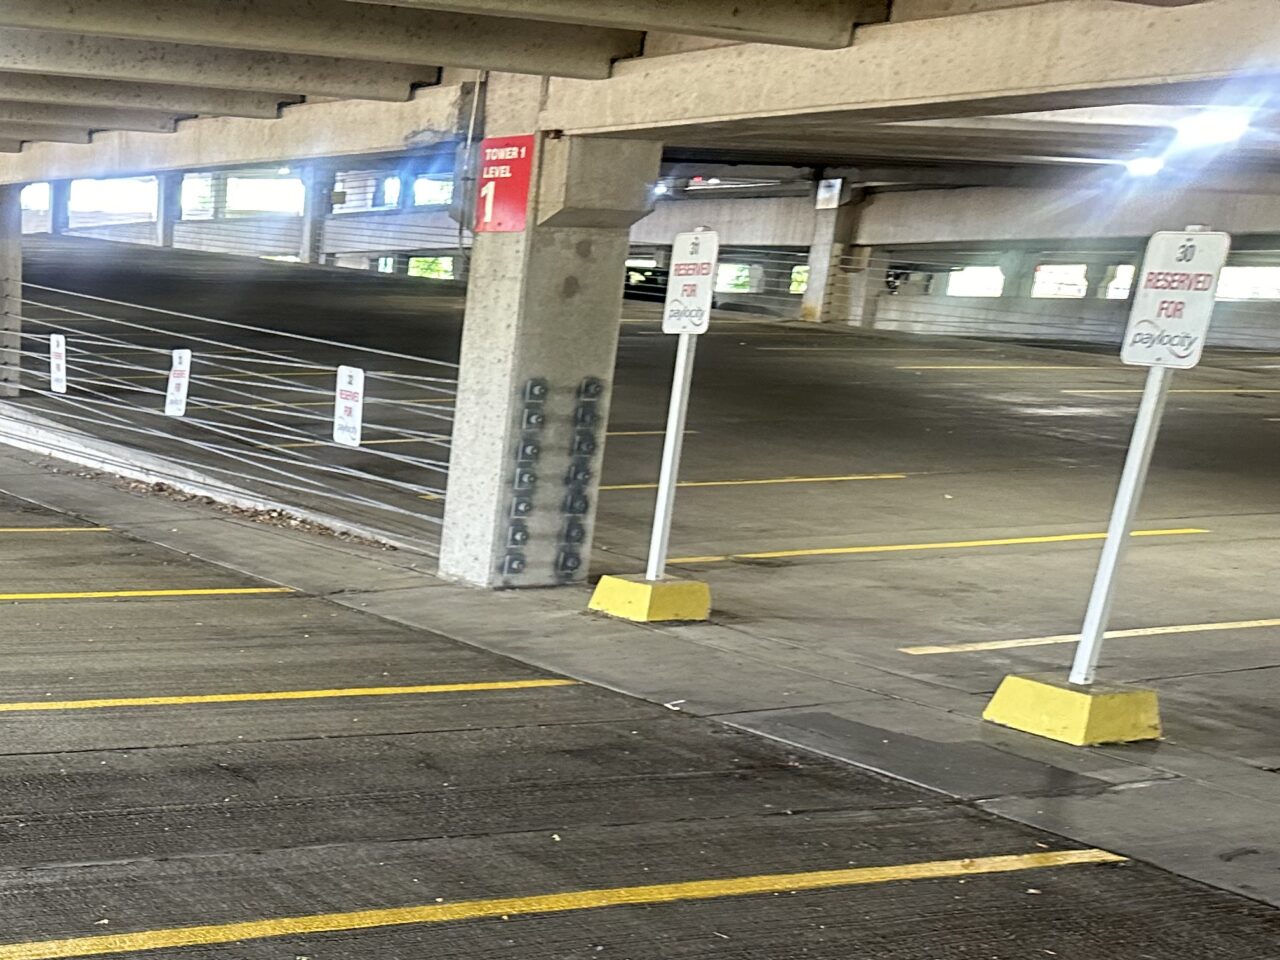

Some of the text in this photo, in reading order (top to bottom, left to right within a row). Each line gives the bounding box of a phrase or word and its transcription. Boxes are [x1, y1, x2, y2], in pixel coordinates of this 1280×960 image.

[485, 146, 527, 160] TOWER 1
[483, 165, 512, 178] LEVEL
[480, 181, 496, 223] 1
[1175, 244, 1196, 262] 30
[674, 262, 712, 276] RESERVED
[681, 284, 698, 297] FOR
[1144, 272, 1213, 291] RESERVED
[1157, 300, 1186, 319] FOR
[1130, 328, 1198, 351] paylocity
